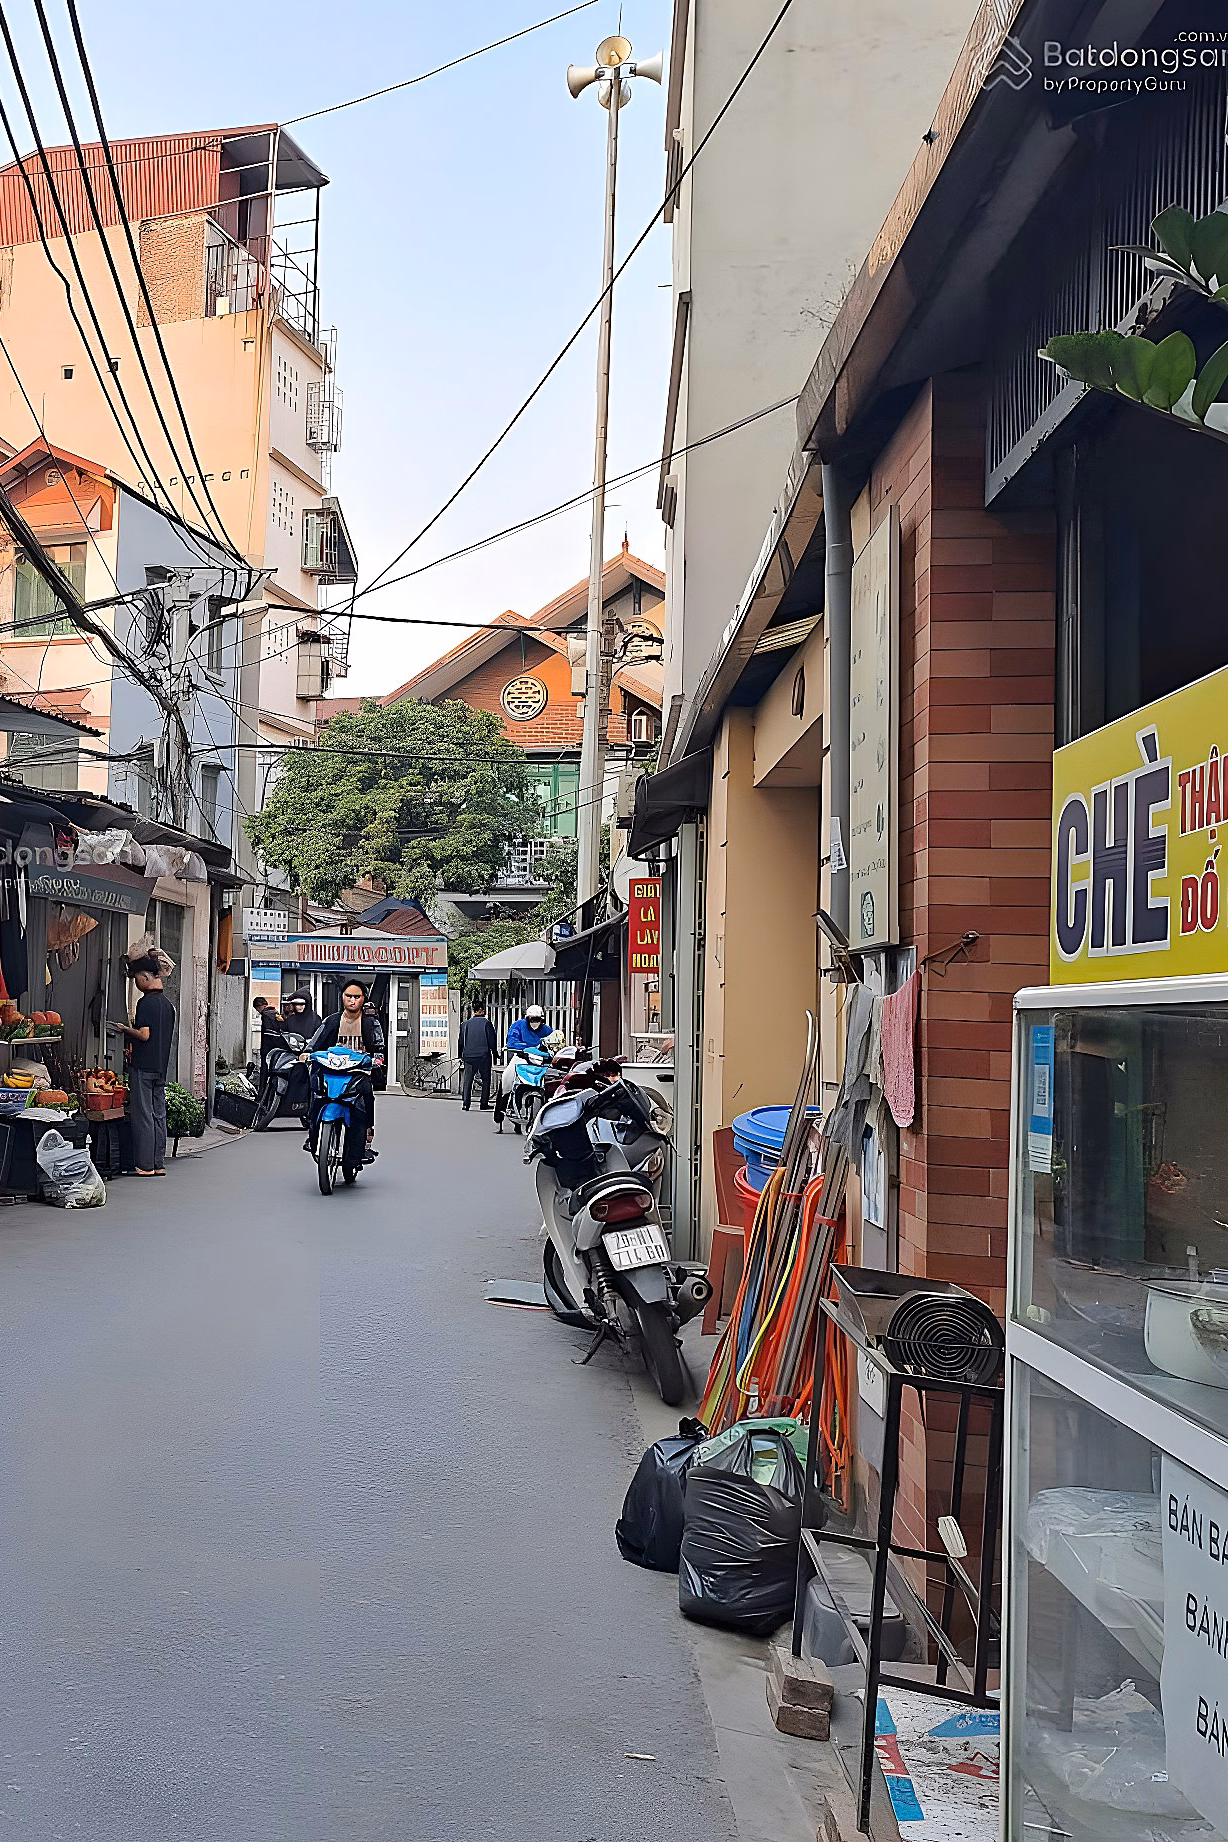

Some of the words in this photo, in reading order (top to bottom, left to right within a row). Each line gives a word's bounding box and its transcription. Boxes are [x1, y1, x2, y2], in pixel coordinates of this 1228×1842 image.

[1056, 723, 1172, 963] CHÈ
[1168, 1493, 1203, 1551] BÁN
[1185, 1592, 1228, 1660] BÁN
